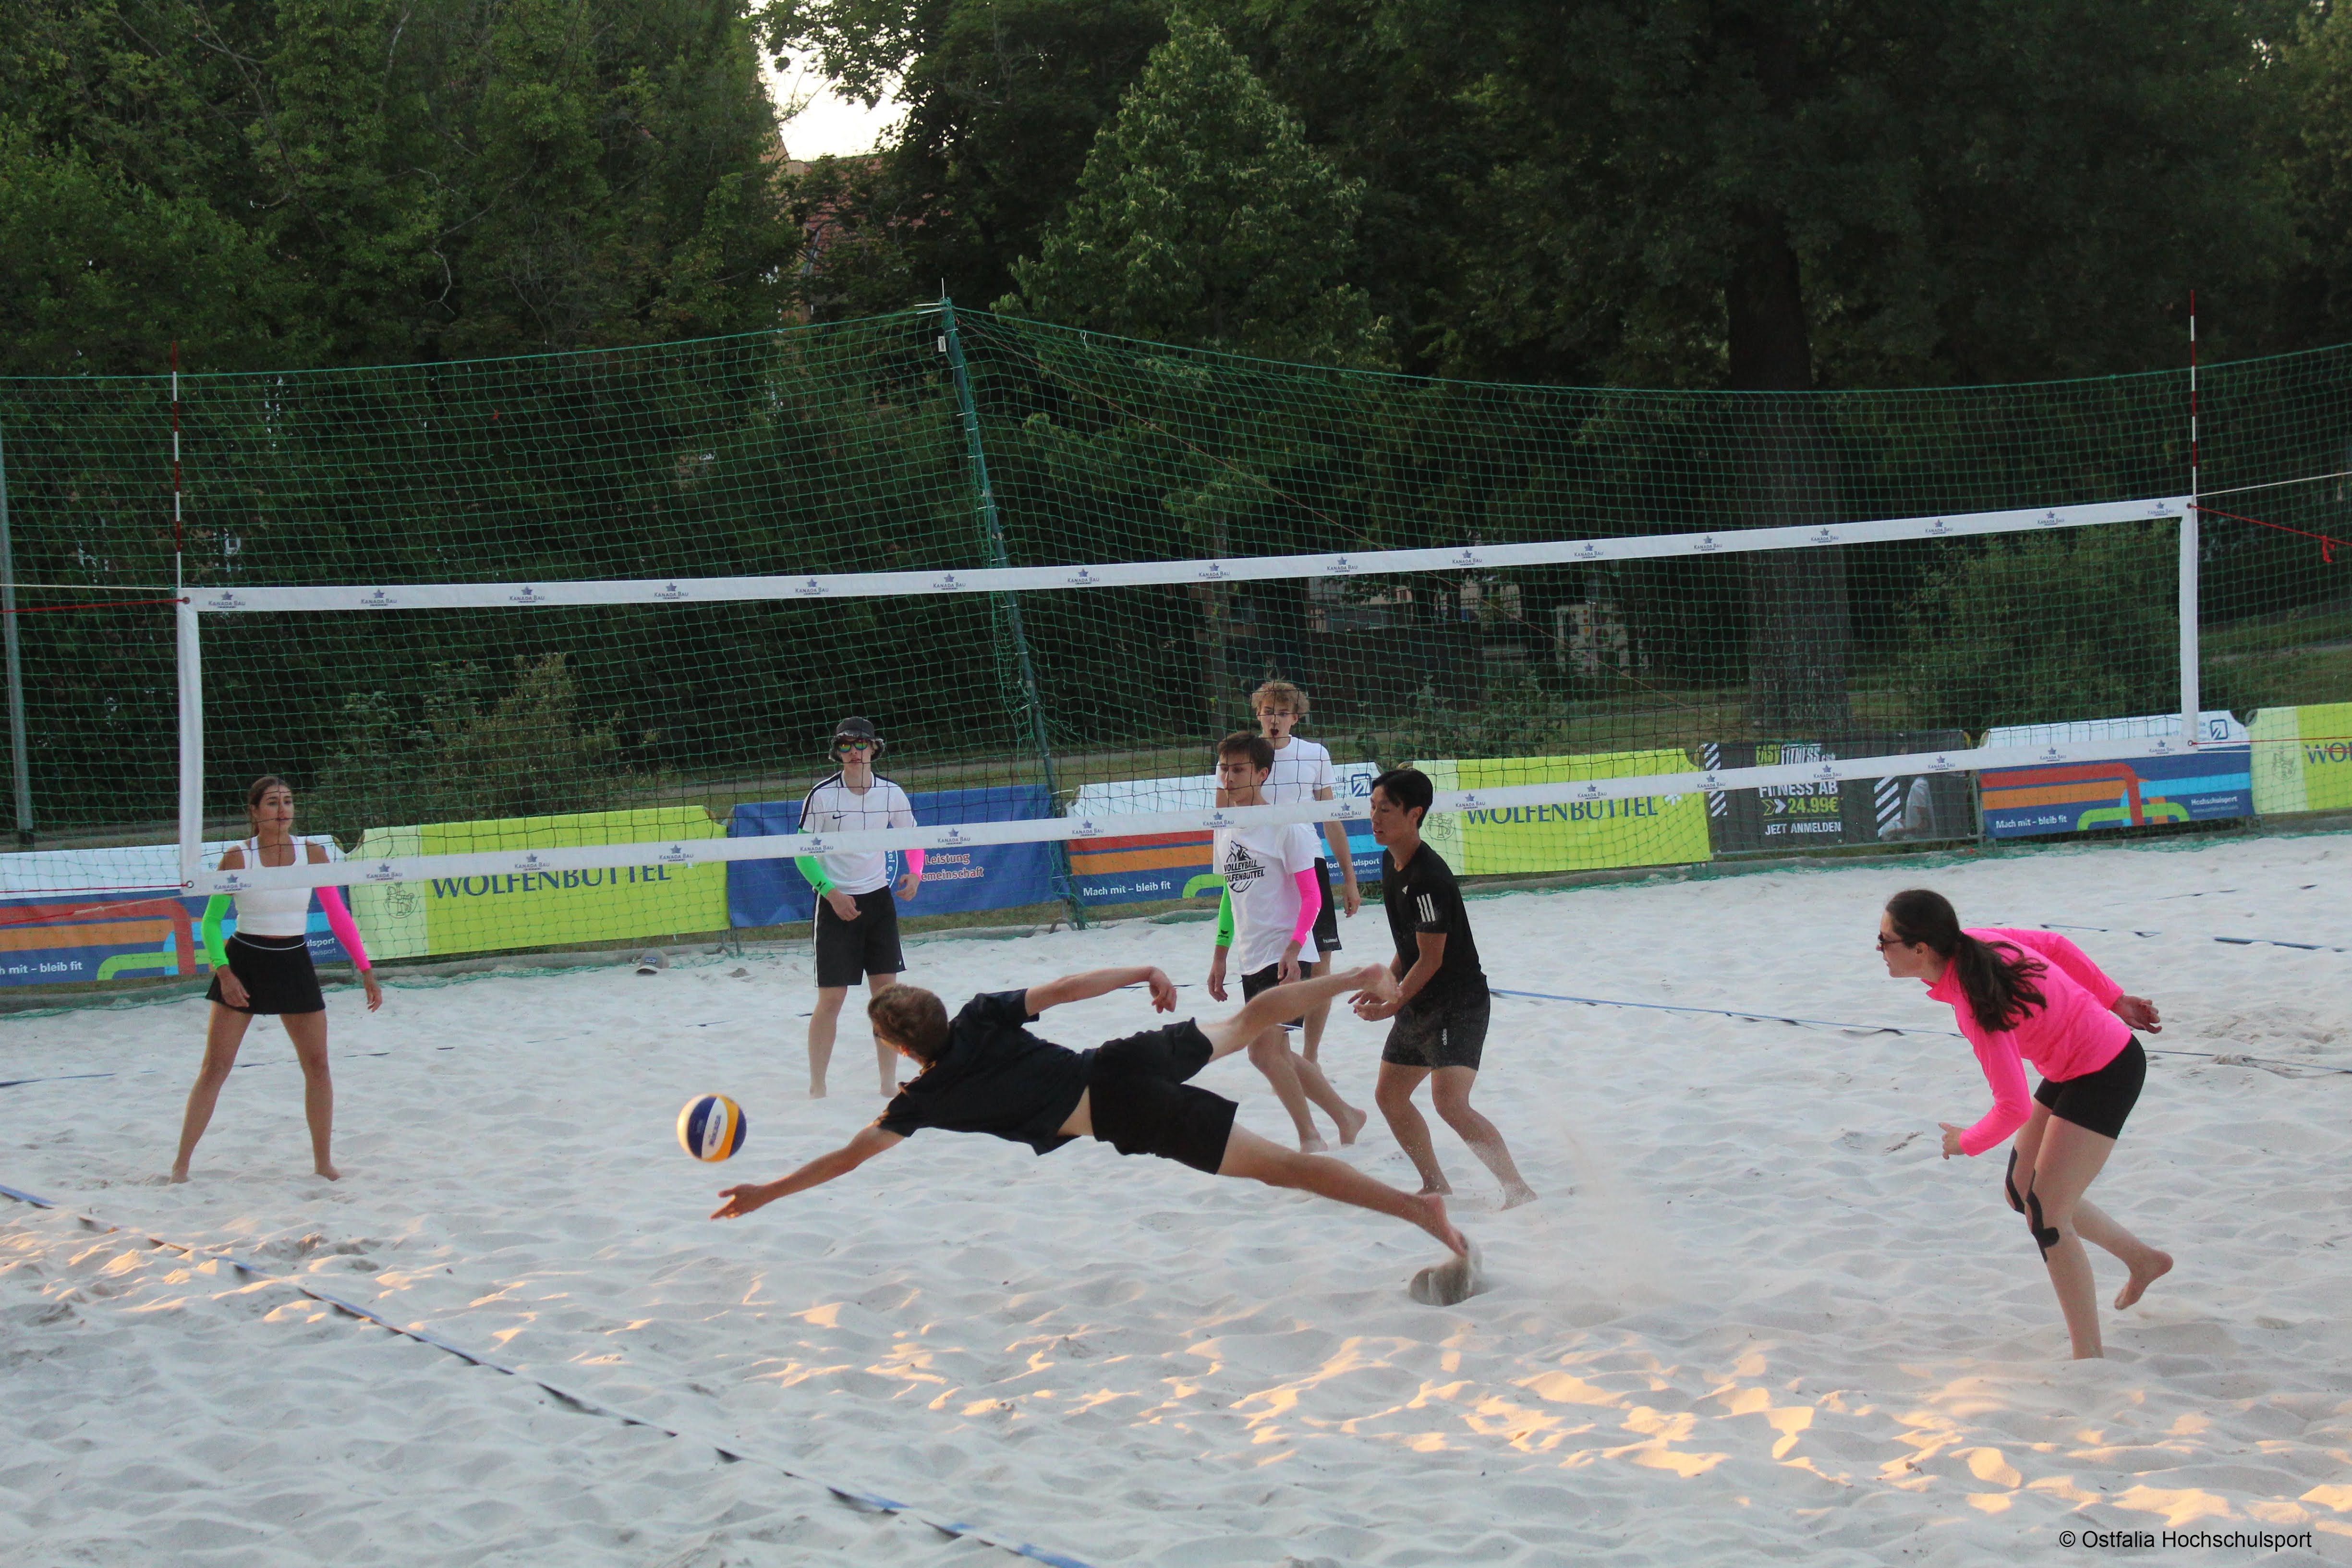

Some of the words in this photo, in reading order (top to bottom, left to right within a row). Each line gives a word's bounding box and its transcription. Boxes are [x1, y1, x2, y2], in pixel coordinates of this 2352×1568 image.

[1819, 780, 1838, 795] AB
[1790, 822, 1842, 833] ANMELDEN
[1996, 819, 2016, 828] Mach
[2018, 818, 2031, 827] mit
[2038, 815, 2057, 825] bleib
[2059, 814, 2067, 823] fit
[925, 853, 970, 865] Leistung
[1224, 860, 1257, 872] VOLLEYBALL
[921, 866, 984, 882] emeinschaft
[1083, 887, 1108, 896] Mach
[1110, 885, 1126, 894] mit
[1136, 882, 1158, 892] bleib
[1161, 881, 1171, 890] fit
[9, 964, 28, 974] mit
[40, 961, 67, 972] bleib
[70, 960, 83, 971] fit
